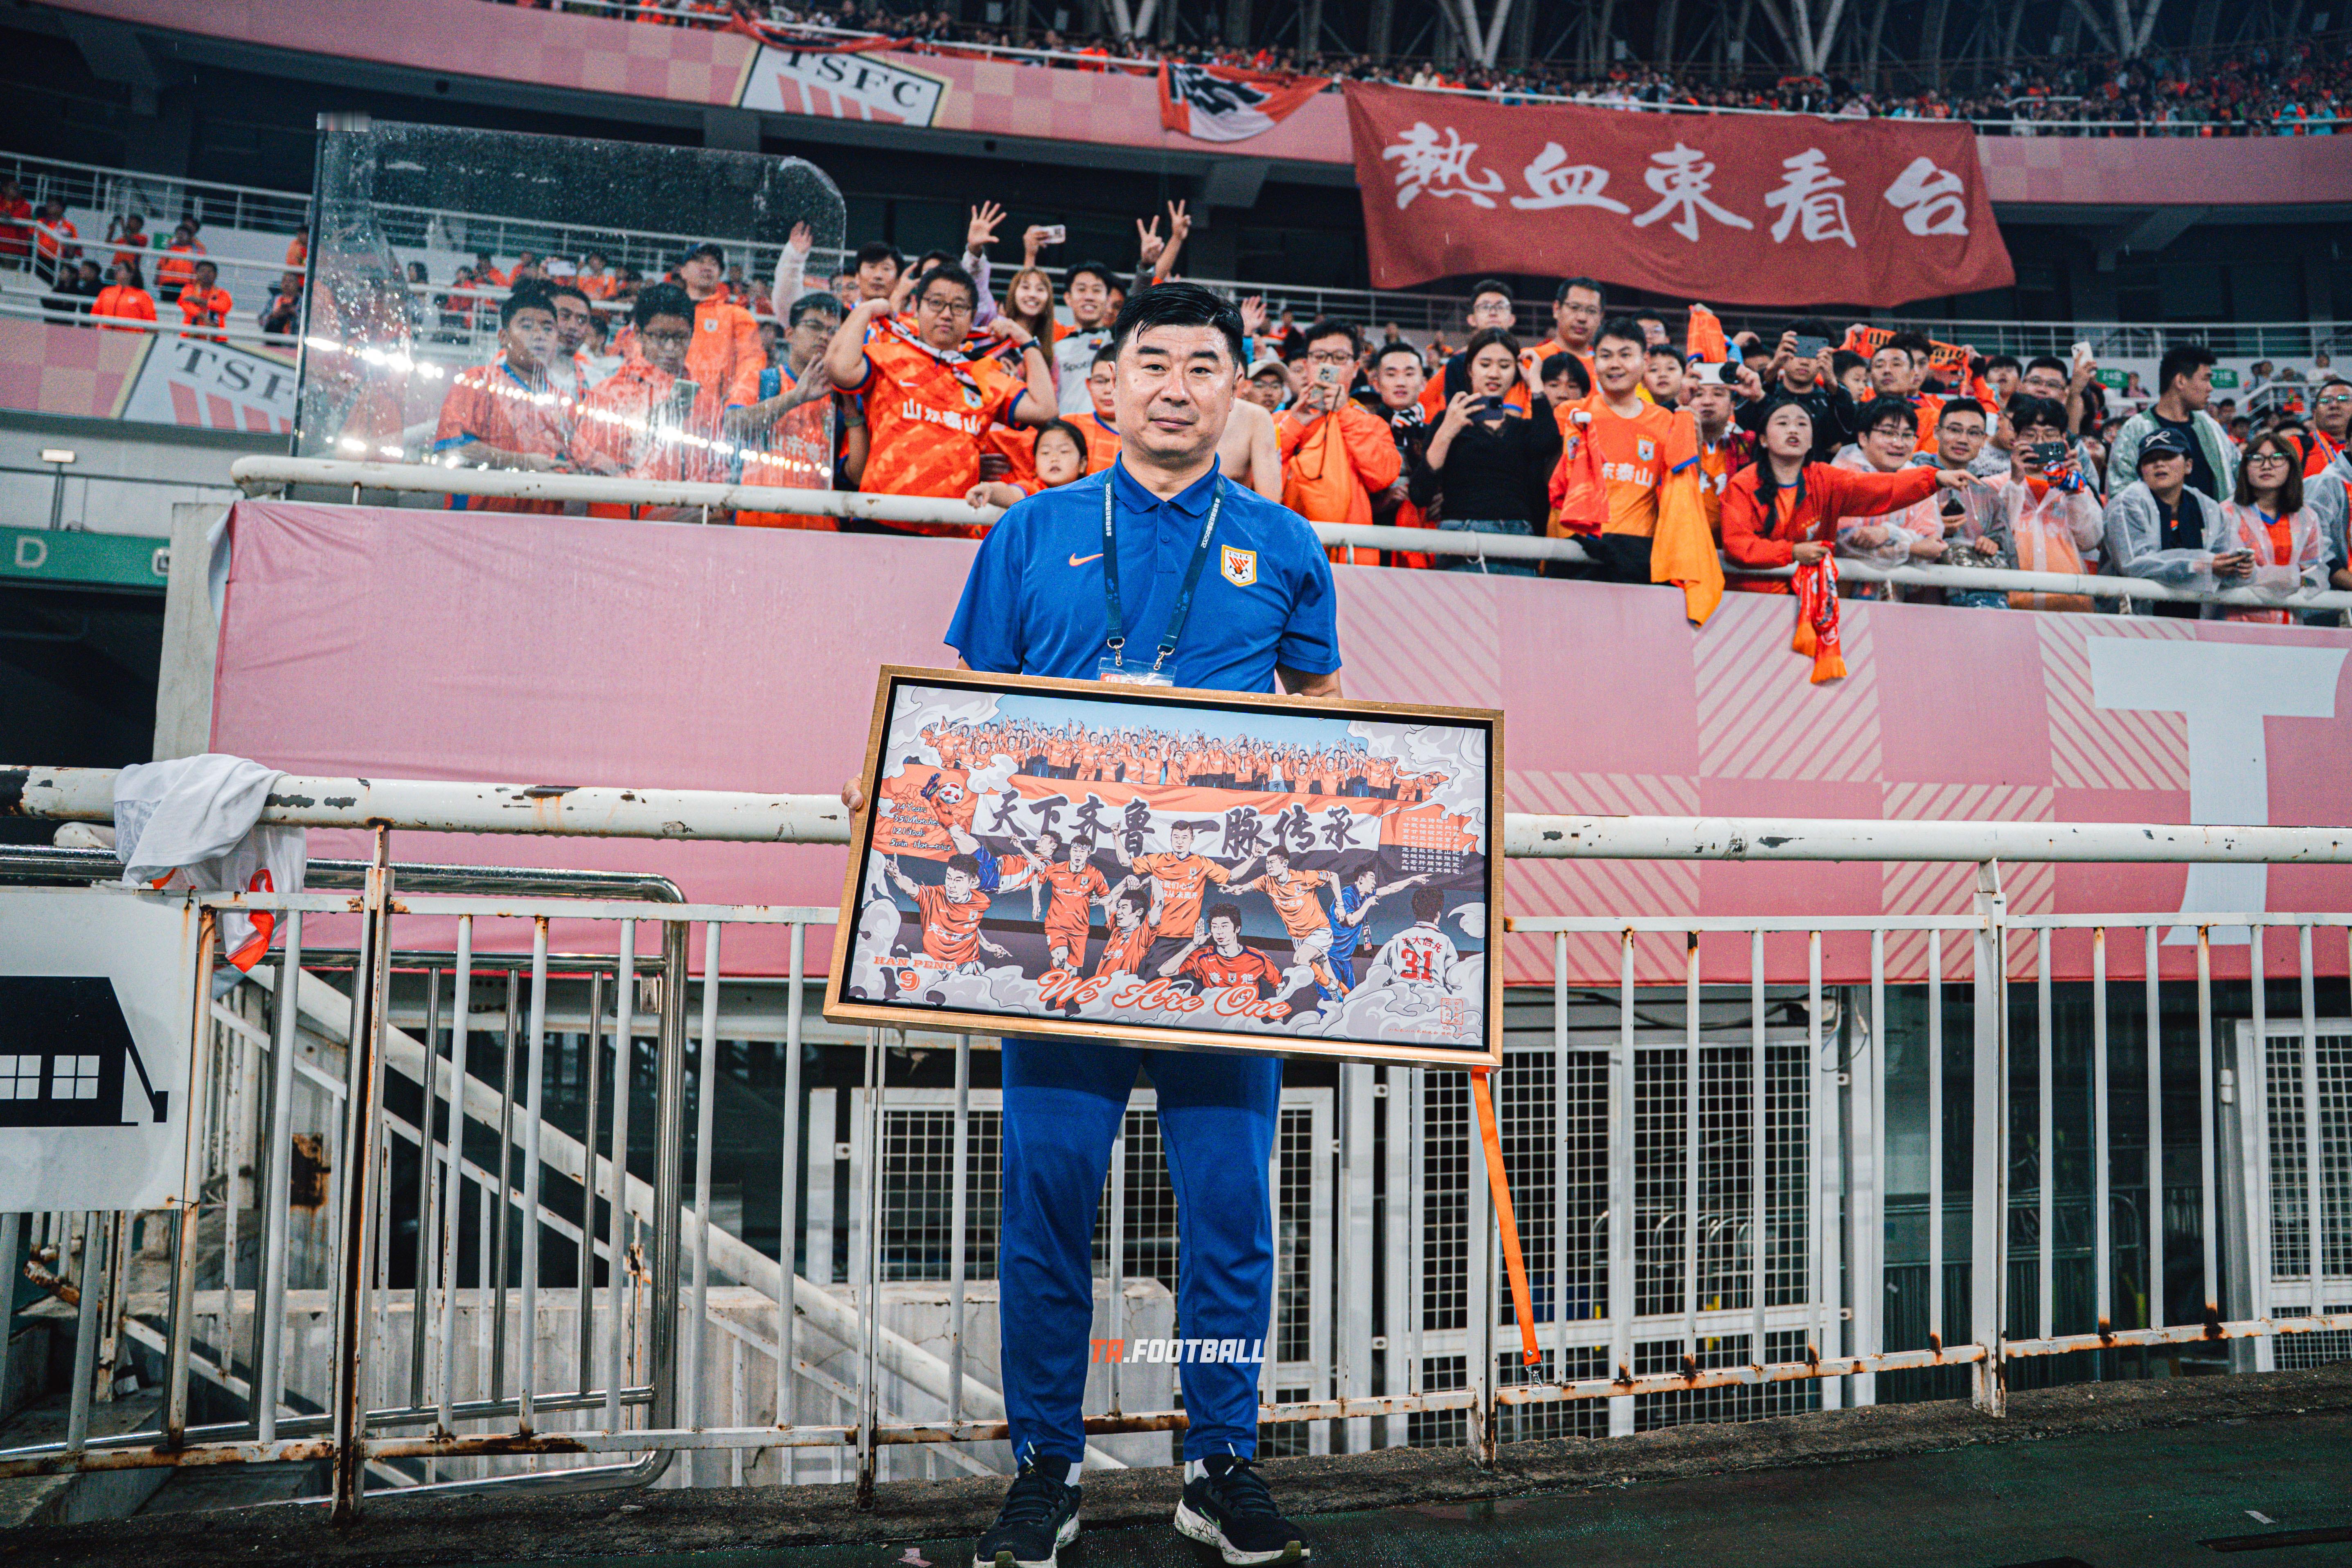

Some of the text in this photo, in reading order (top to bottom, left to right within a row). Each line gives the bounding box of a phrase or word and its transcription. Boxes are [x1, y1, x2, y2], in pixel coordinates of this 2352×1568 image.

[1382, 121, 1970, 248] 熱血東看台
[175, 342, 295, 404] TSF
[902, 398, 982, 436] 山东泰山
[1602, 462, 1654, 488] 东泰山
[15, 536, 47, 568] D
[1227, 550, 1250, 560] TSFC
[988, 791, 1360, 858] 天下齐鲁 一脉传承
[874, 956, 957, 971] HAN PENG
[899, 970, 921, 992] 9
[1400, 947, 1433, 983] 31
[1036, 968, 1293, 1018] We Are One
